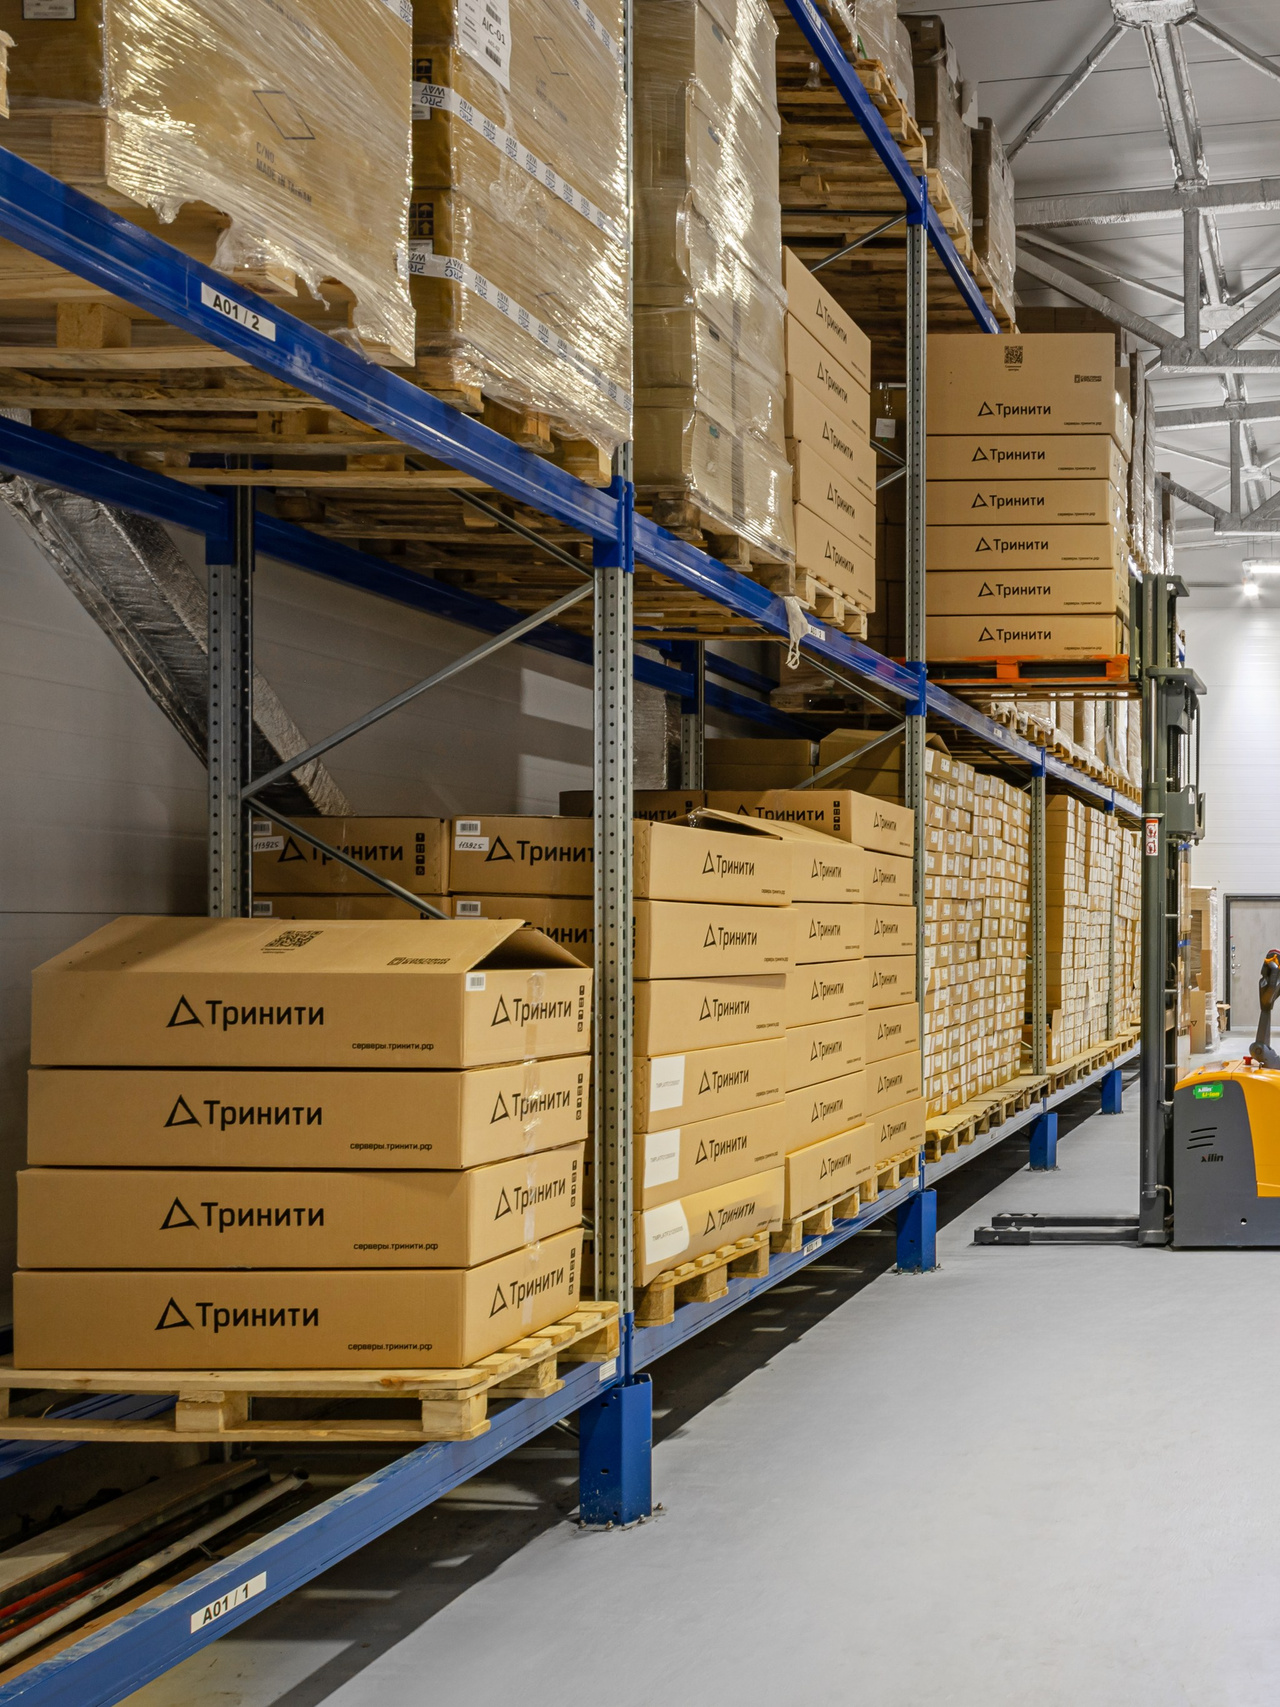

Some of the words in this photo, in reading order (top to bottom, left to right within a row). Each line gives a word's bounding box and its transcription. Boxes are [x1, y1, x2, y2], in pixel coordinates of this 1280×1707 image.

[482, 17, 505, 45] AIC-01
[420, 94, 443, 107] PRO
[422, 84, 445, 97] WAY
[444, 267, 463, 282] PRO
[446, 258, 464, 271] WAY
[211, 294, 240, 321] A01
[251, 315, 261, 332] 2
[824, 306, 848, 345] Тринити
[825, 368, 848, 403] Тринити
[995, 403, 1051, 418] Тринити
[830, 427, 854, 461] Тринити
[990, 449, 1045, 463] Тринити
[834, 489, 855, 519] Тринити
[989, 495, 1045, 509] Тринити
[993, 539, 1049, 553] Тринити
[832, 544, 854, 574] Тринити
[996, 583, 1051, 598] Тринити
[996, 628, 1052, 643] Тринити
[878, 813, 897, 832] Тринити
[716, 855, 755, 878] Тринити
[818, 859, 842, 880] Тринити
[878, 868, 897, 886] Тринити
[817, 918, 841, 940] Тринити
[879, 919, 899, 937] Тринити
[719, 929, 758, 950] Тринити
[877, 970, 897, 987] Тринити
[819, 979, 845, 1000] Тринити
[206, 1000, 325, 1032] Тринити
[513, 998, 572, 1027] Тринити
[713, 999, 750, 1021] Тринити
[882, 1022, 902, 1040] Тринити
[352, 1041, 434, 1051] серверы.тринити.рф
[819, 1040, 843, 1061] Тринити
[712, 1069, 749, 1093] Тринити
[883, 1073, 903, 1092] Тринити
[511, 1089, 571, 1115] Тринити
[820, 1098, 844, 1119] Тринити
[203, 1100, 323, 1130] Тринити
[887, 1120, 907, 1138] Тринити
[350, 1141, 433, 1151] серверы.тринити.рф
[709, 1135, 748, 1164] Тринити
[828, 1153, 851, 1176] Тринити
[514, 1178, 566, 1211] Тринити
[201, 1203, 325, 1233] Тринити
[717, 1202, 755, 1225] Тринити
[353, 1242, 438, 1252] серверы.тринити.рф
[509, 1267, 564, 1310] Тринити
[196, 1302, 319, 1333] Тринити
[348, 1342, 433, 1352] серверы.тринити.рф
[202, 1598, 229, 1625] A01
[242, 1584, 251, 1600] 1
